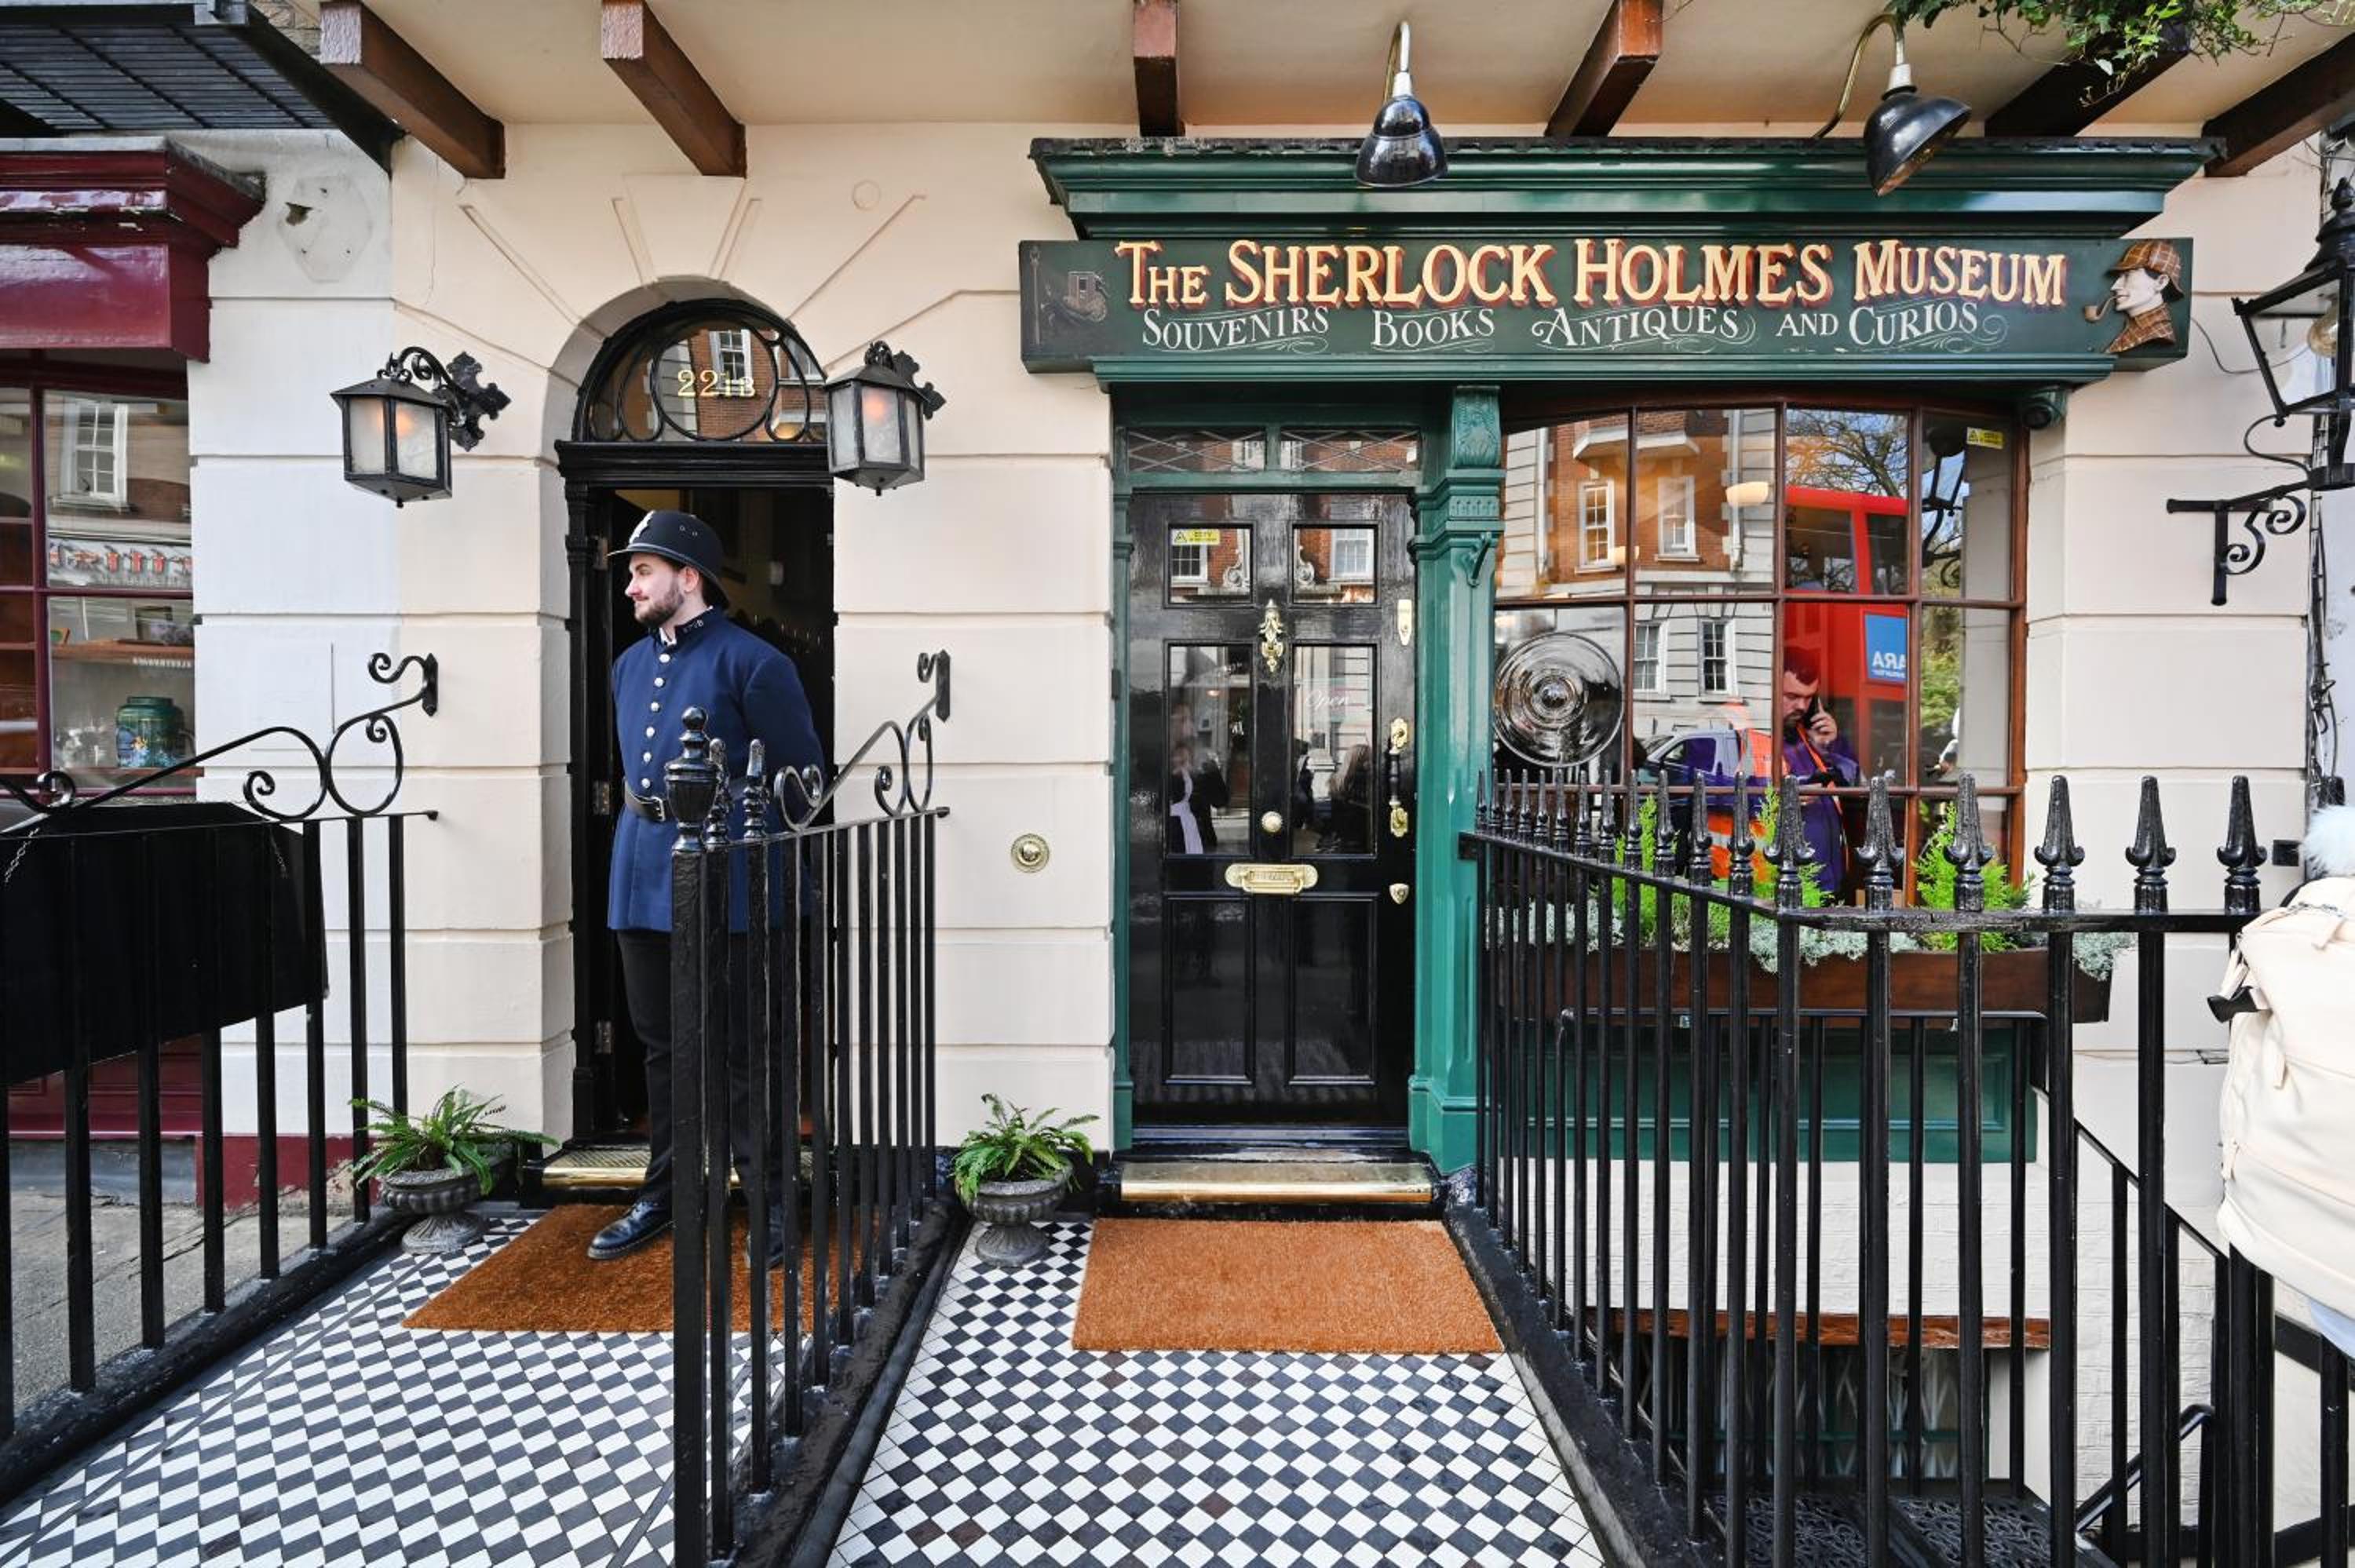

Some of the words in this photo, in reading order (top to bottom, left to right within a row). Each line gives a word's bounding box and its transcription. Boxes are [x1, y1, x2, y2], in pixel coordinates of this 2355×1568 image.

[1115, 241, 1210, 307] THE
[1225, 240, 1557, 308] SHERLOCK
[1573, 239, 1834, 307] HOLMES
[1853, 239, 2067, 307] MUSEUM
[1143, 305, 1329, 350] SOUVENIRS
[1371, 308, 1495, 347] BOOKS
[1532, 306, 1740, 346] ANTIQUES
[1776, 313, 1839, 337] AND
[1849, 301, 1977, 345] CURIOS
